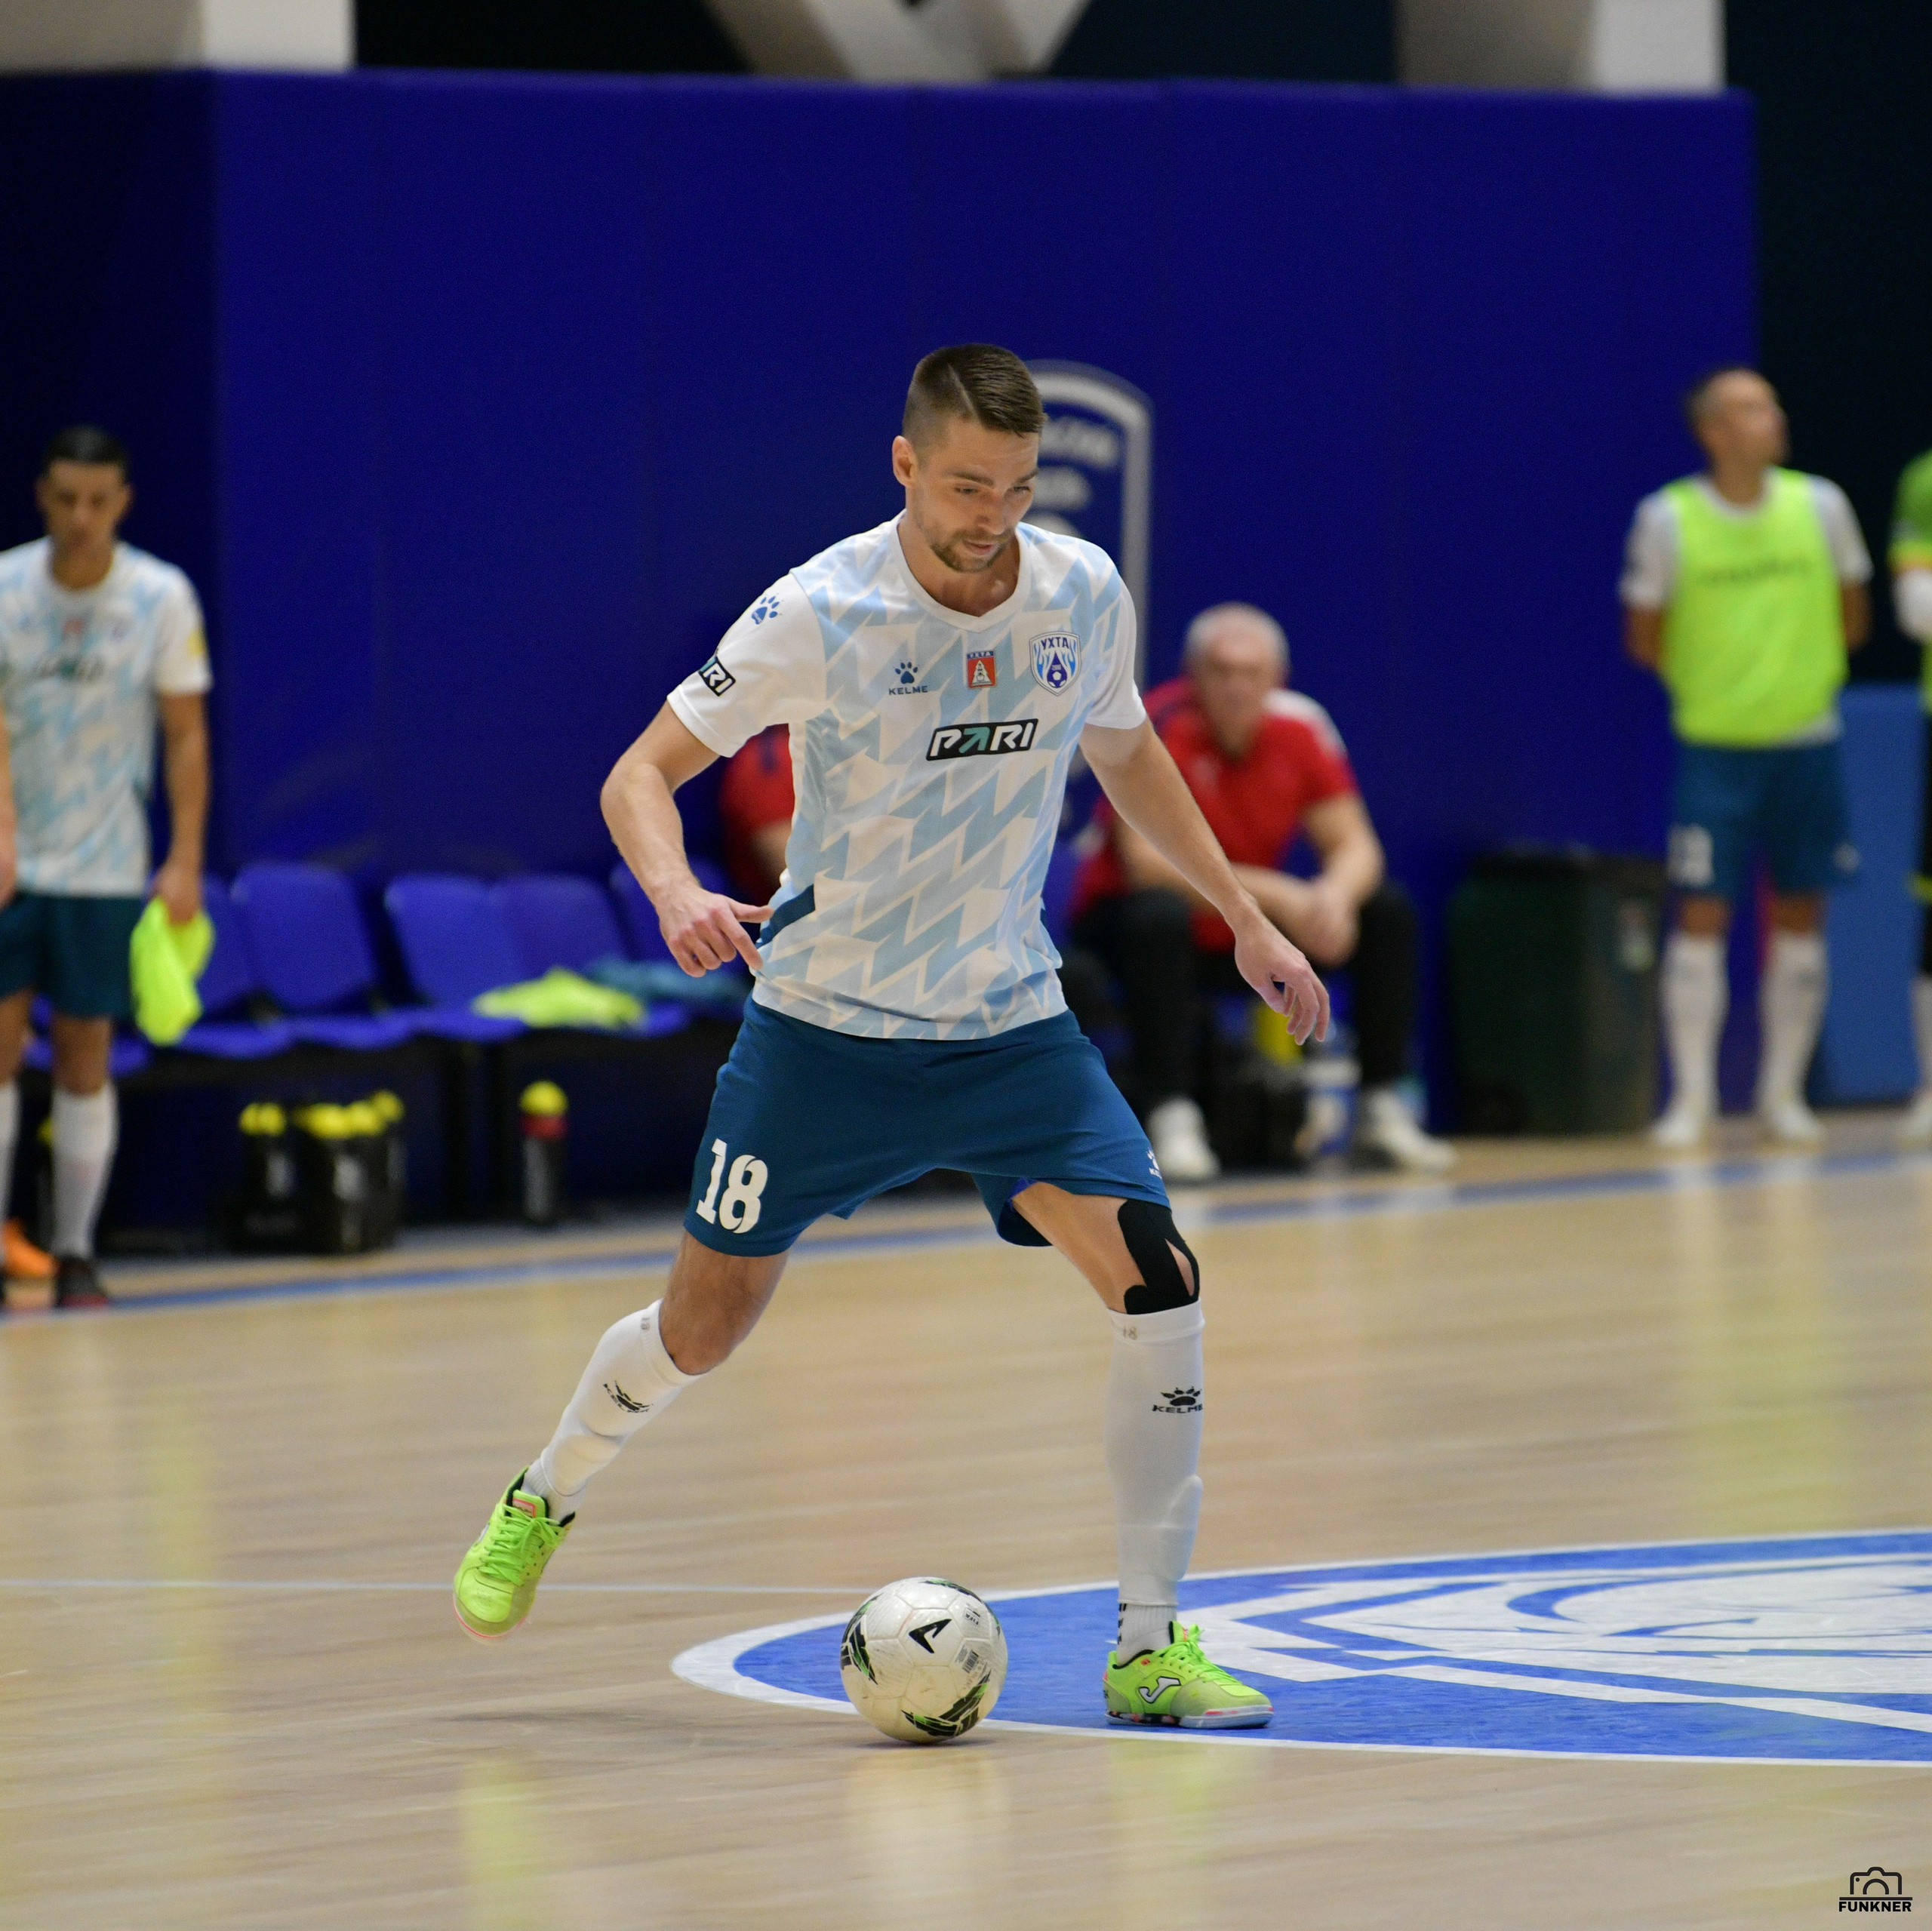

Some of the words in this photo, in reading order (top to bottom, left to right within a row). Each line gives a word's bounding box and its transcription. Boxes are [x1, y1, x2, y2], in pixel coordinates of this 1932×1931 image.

[1041, 637, 1069, 650] УХТА
[889, 685, 928, 695] KELME
[929, 722, 1034, 757] PARI
[696, 1138, 768, 1234] 18
